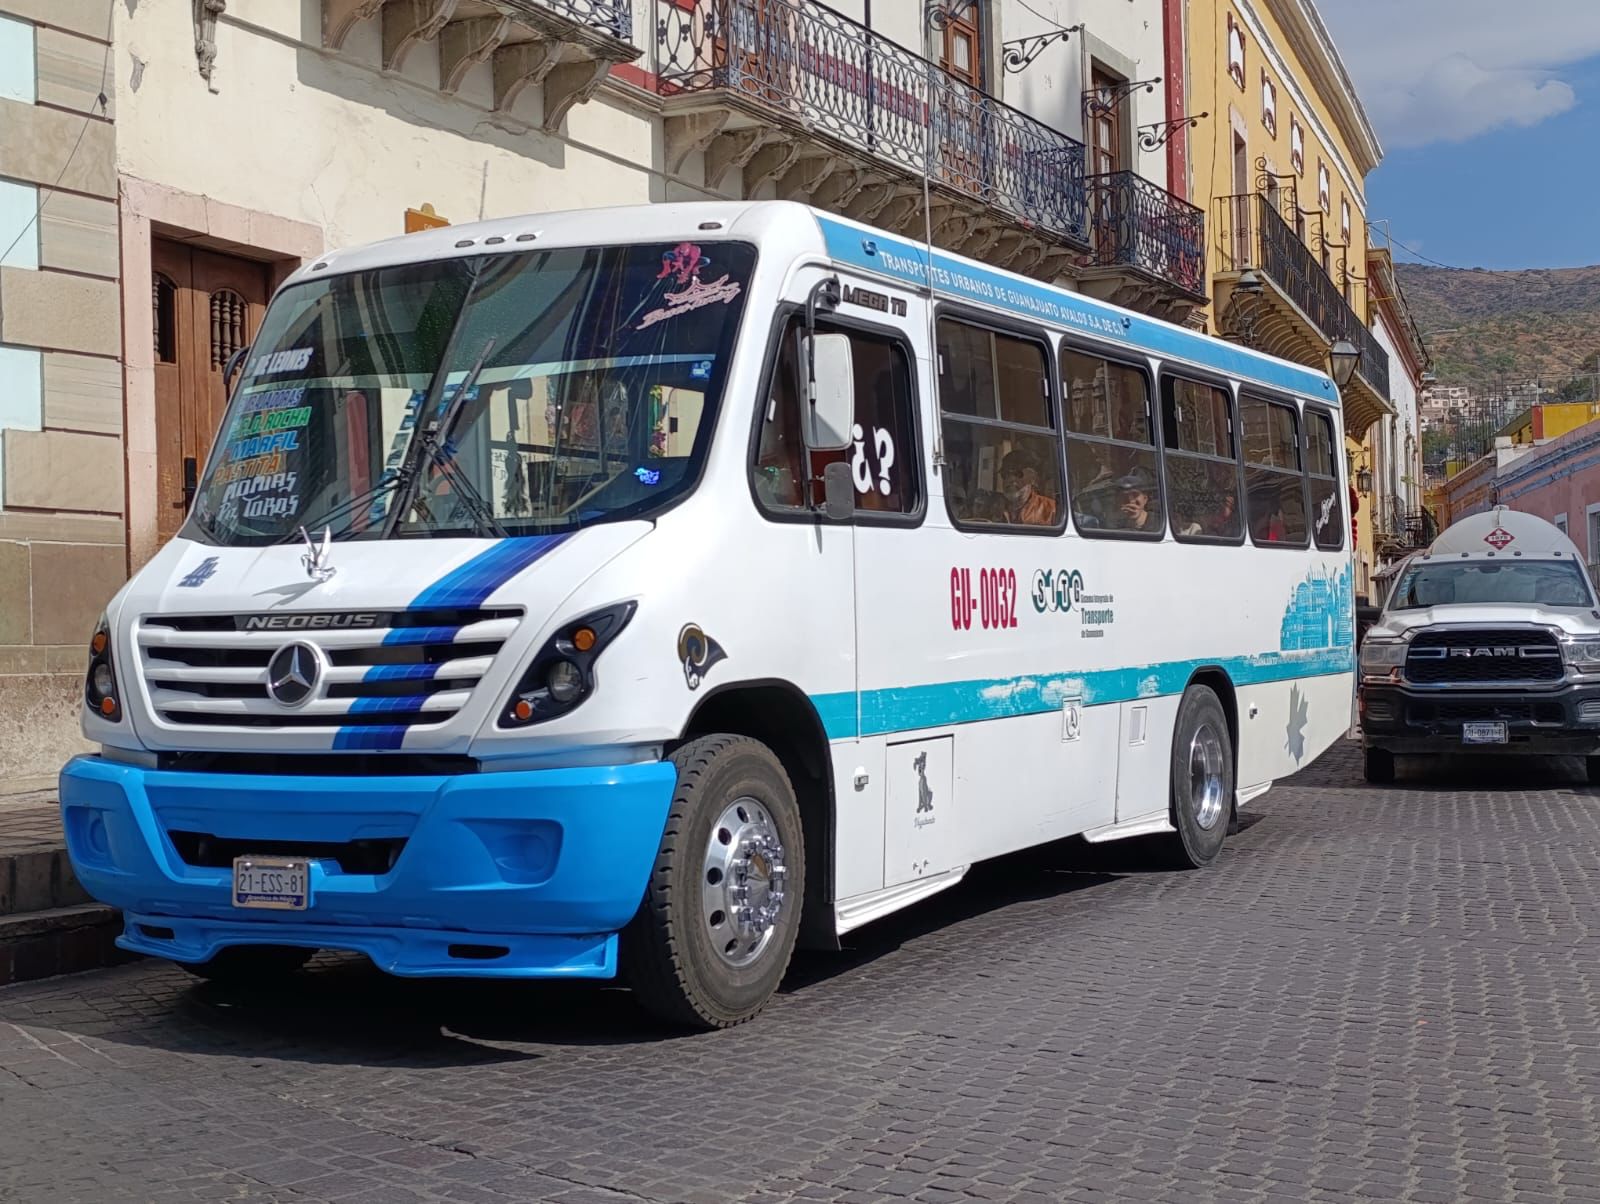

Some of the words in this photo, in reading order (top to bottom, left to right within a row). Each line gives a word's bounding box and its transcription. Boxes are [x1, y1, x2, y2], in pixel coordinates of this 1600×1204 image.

[843, 284, 889, 313] MEGA
[951, 272, 993, 298] URBANOS
[994, 285, 1007, 301] DE
[1007, 289, 1059, 317] GUANAJUATO
[266, 347, 314, 375] LEONES
[263, 406, 312, 430] ROCHA
[229, 430, 299, 462] MARFIL
[212, 453, 281, 485] PASTITA
[222, 471, 297, 504] MOMIAS
[242, 494, 299, 518] TOROS
[950, 567, 1017, 631] GU-0032
[246, 614, 377, 629] NEOBUS
[1081, 608, 1114, 626] Transporte
[1450, 648, 1515, 657] RAM
[239, 873, 304, 893] 21-ESS-81
